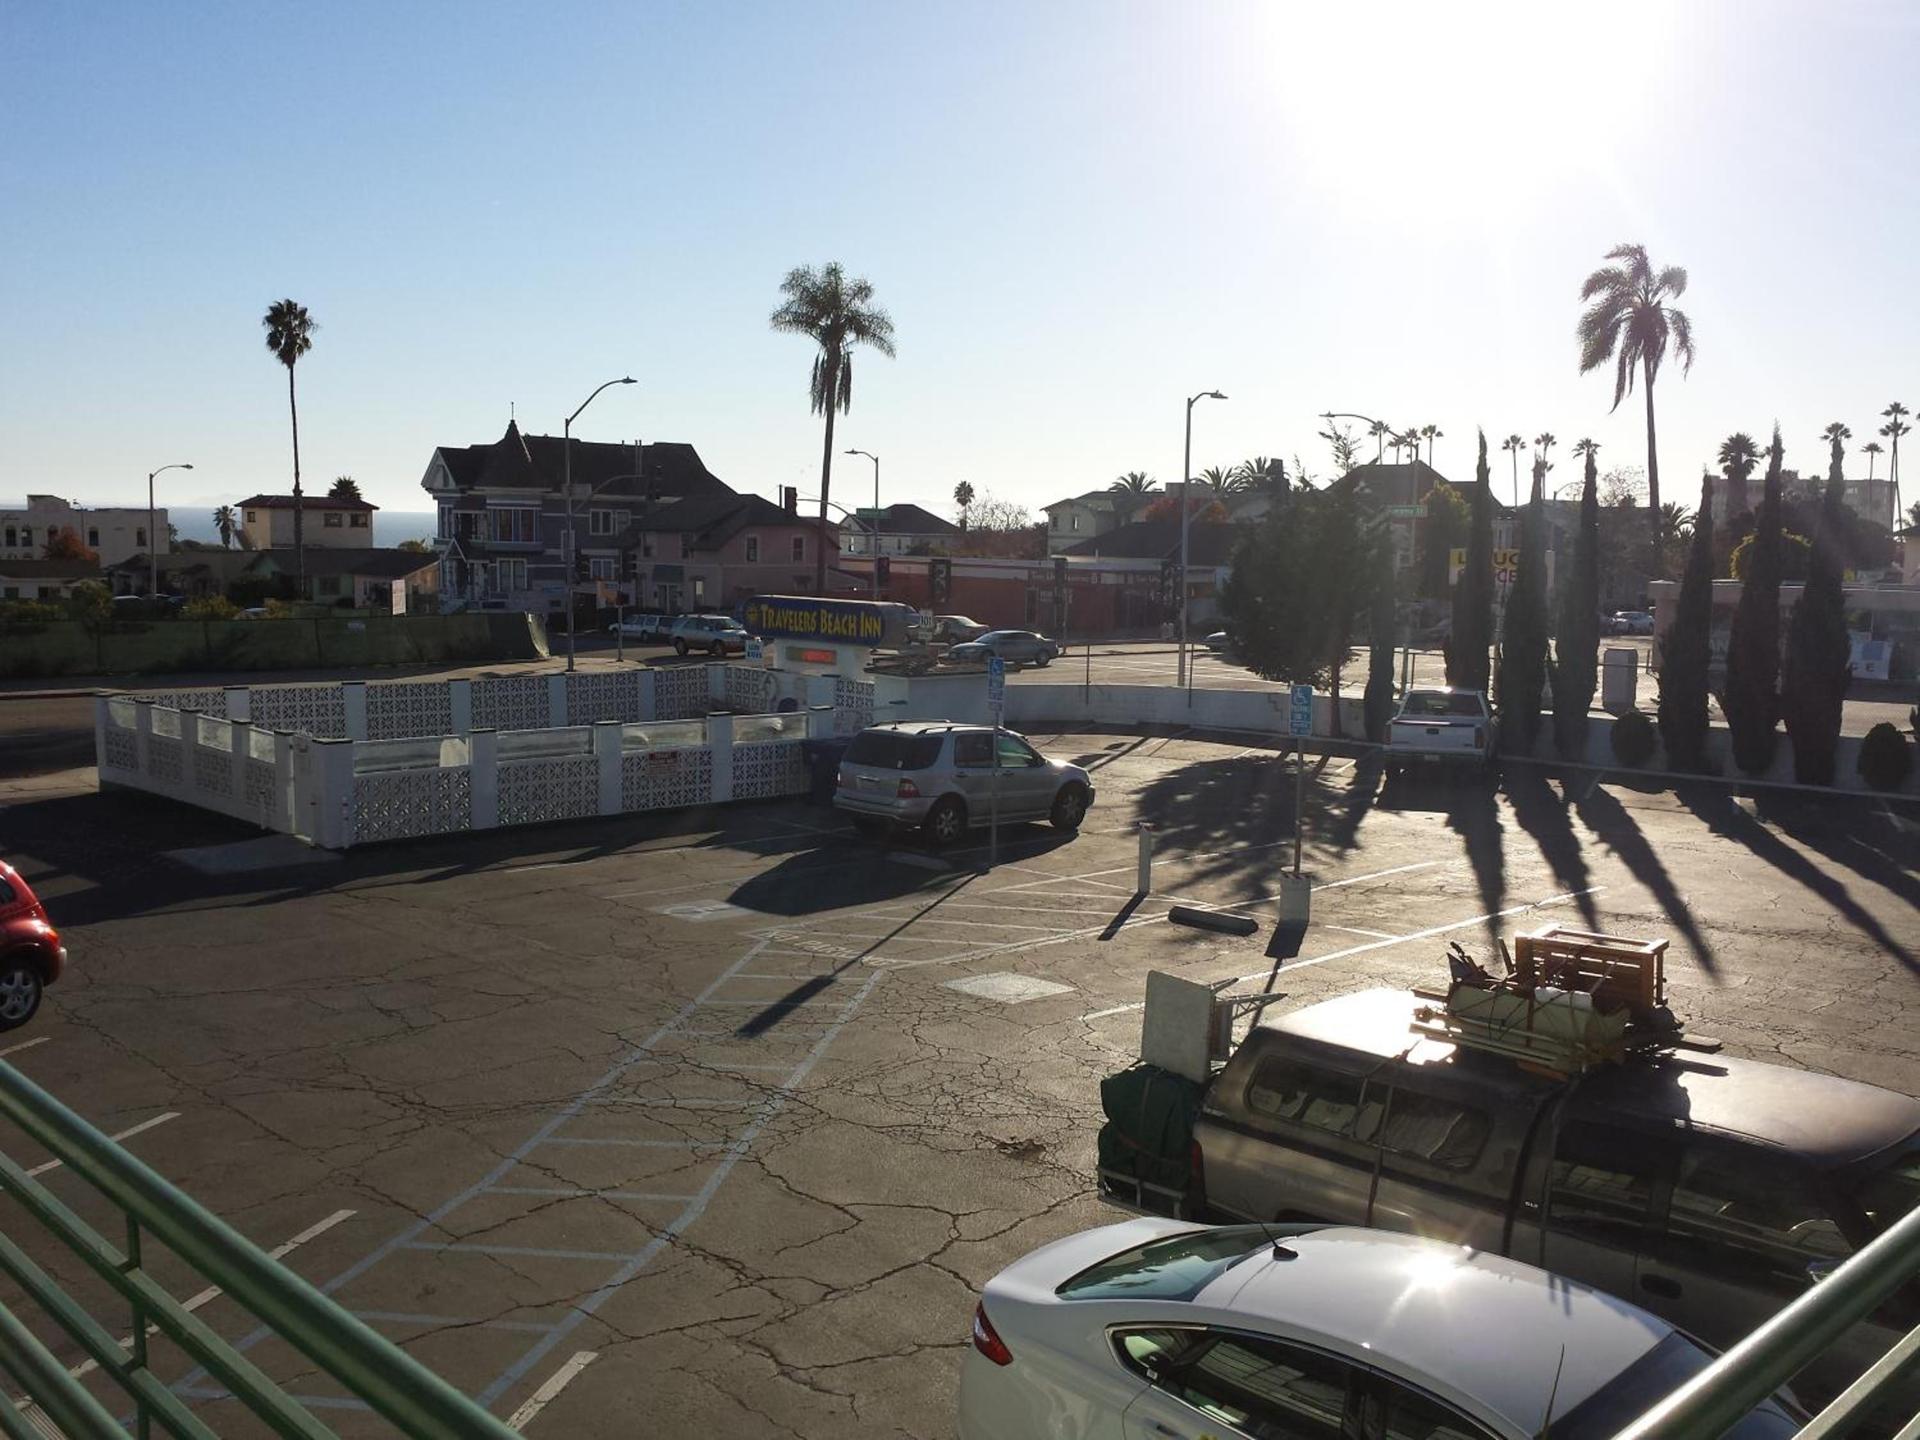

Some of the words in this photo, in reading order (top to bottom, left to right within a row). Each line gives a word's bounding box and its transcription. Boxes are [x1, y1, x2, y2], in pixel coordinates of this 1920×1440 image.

[761, 604, 817, 632] TRAVELERS
[820, 608, 857, 637] BEACH
[860, 611, 881, 639] INN
